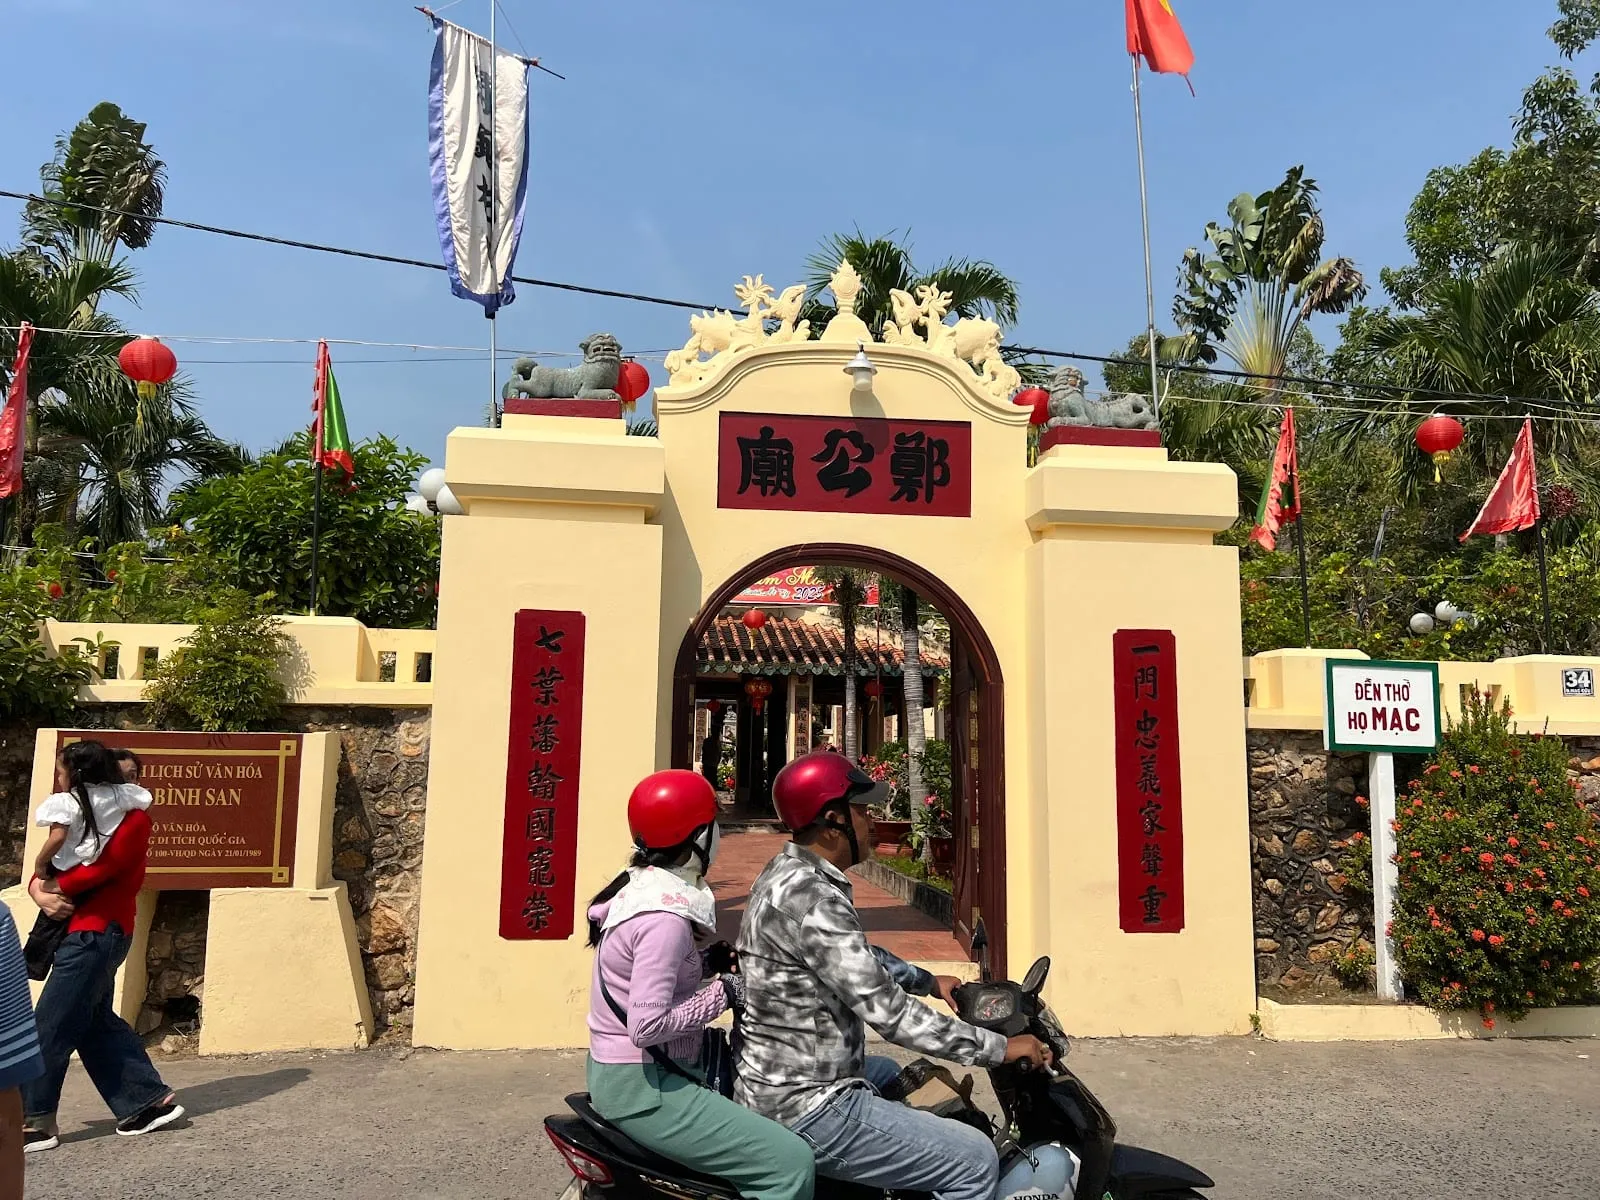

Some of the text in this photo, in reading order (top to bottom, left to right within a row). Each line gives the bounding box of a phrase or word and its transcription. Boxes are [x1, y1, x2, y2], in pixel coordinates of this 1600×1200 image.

[1566, 671, 1591, 688] 34
[1384, 679, 1410, 701] THỜ
[1348, 706, 1420, 735] HỌ MẠC
[150, 765, 183, 780] LỊCH
[186, 761, 203, 779] SỬ
[206, 763, 233, 779] VĂN
[236, 763, 263, 779] HÓA
[154, 783, 242, 806] BÌNH SAN
[163, 823, 184, 832] VĂN
[158, 836, 169, 845] DI
[171, 835, 196, 845] TÍCH
[198, 833, 227, 846] QUỐC
[229, 836, 247, 845] GIA
[199, 849, 223, 857] NGÀY
[225, 849, 262, 857] 21/01/1989
